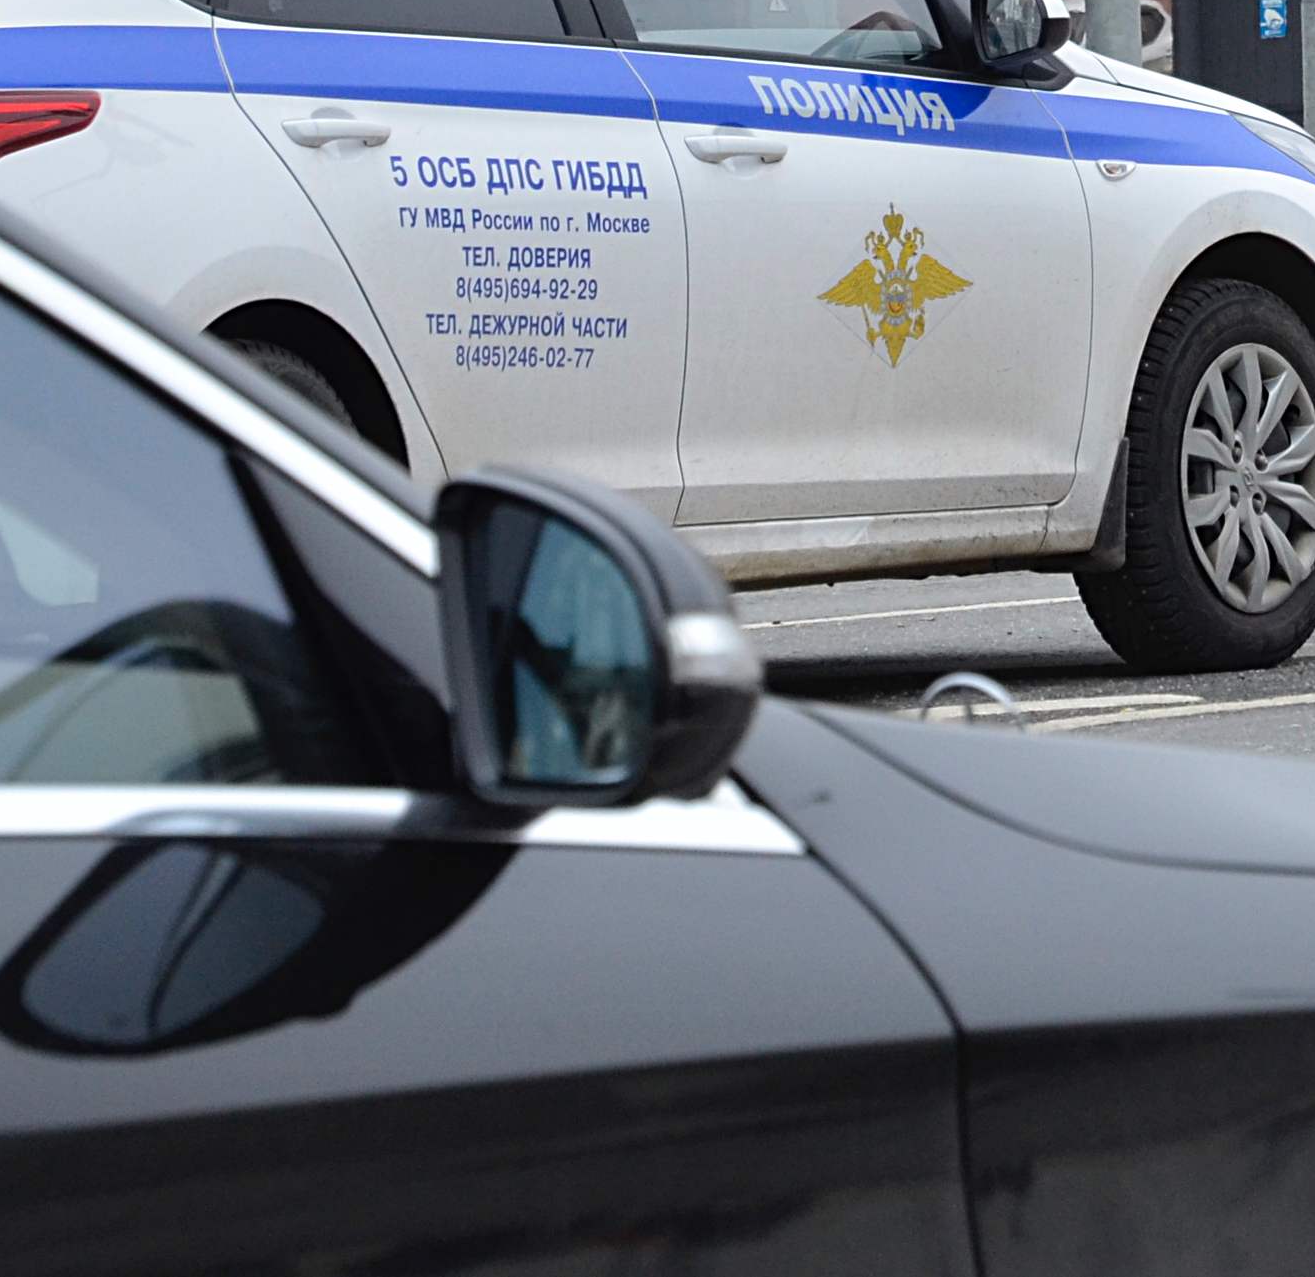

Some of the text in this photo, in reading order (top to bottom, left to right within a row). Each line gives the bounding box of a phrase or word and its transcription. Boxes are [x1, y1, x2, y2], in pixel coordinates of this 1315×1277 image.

[748, 75, 956, 136] ПОЛИЦИЯ
[389, 155, 648, 200] 5 ОСБ ДПС ГИБДД
[398, 207, 651, 234] ГУ МВД России по г. Москве
[462, 246, 592, 272] ТЕЛ. ДОВЕРИЯ
[455, 276, 598, 303] 8(495)694-92-29
[426, 312, 628, 339] ТЕЛ. ДЕЖУРНОЙ ЧАСТИ
[455, 344, 595, 372] 8(495)246-02-77
